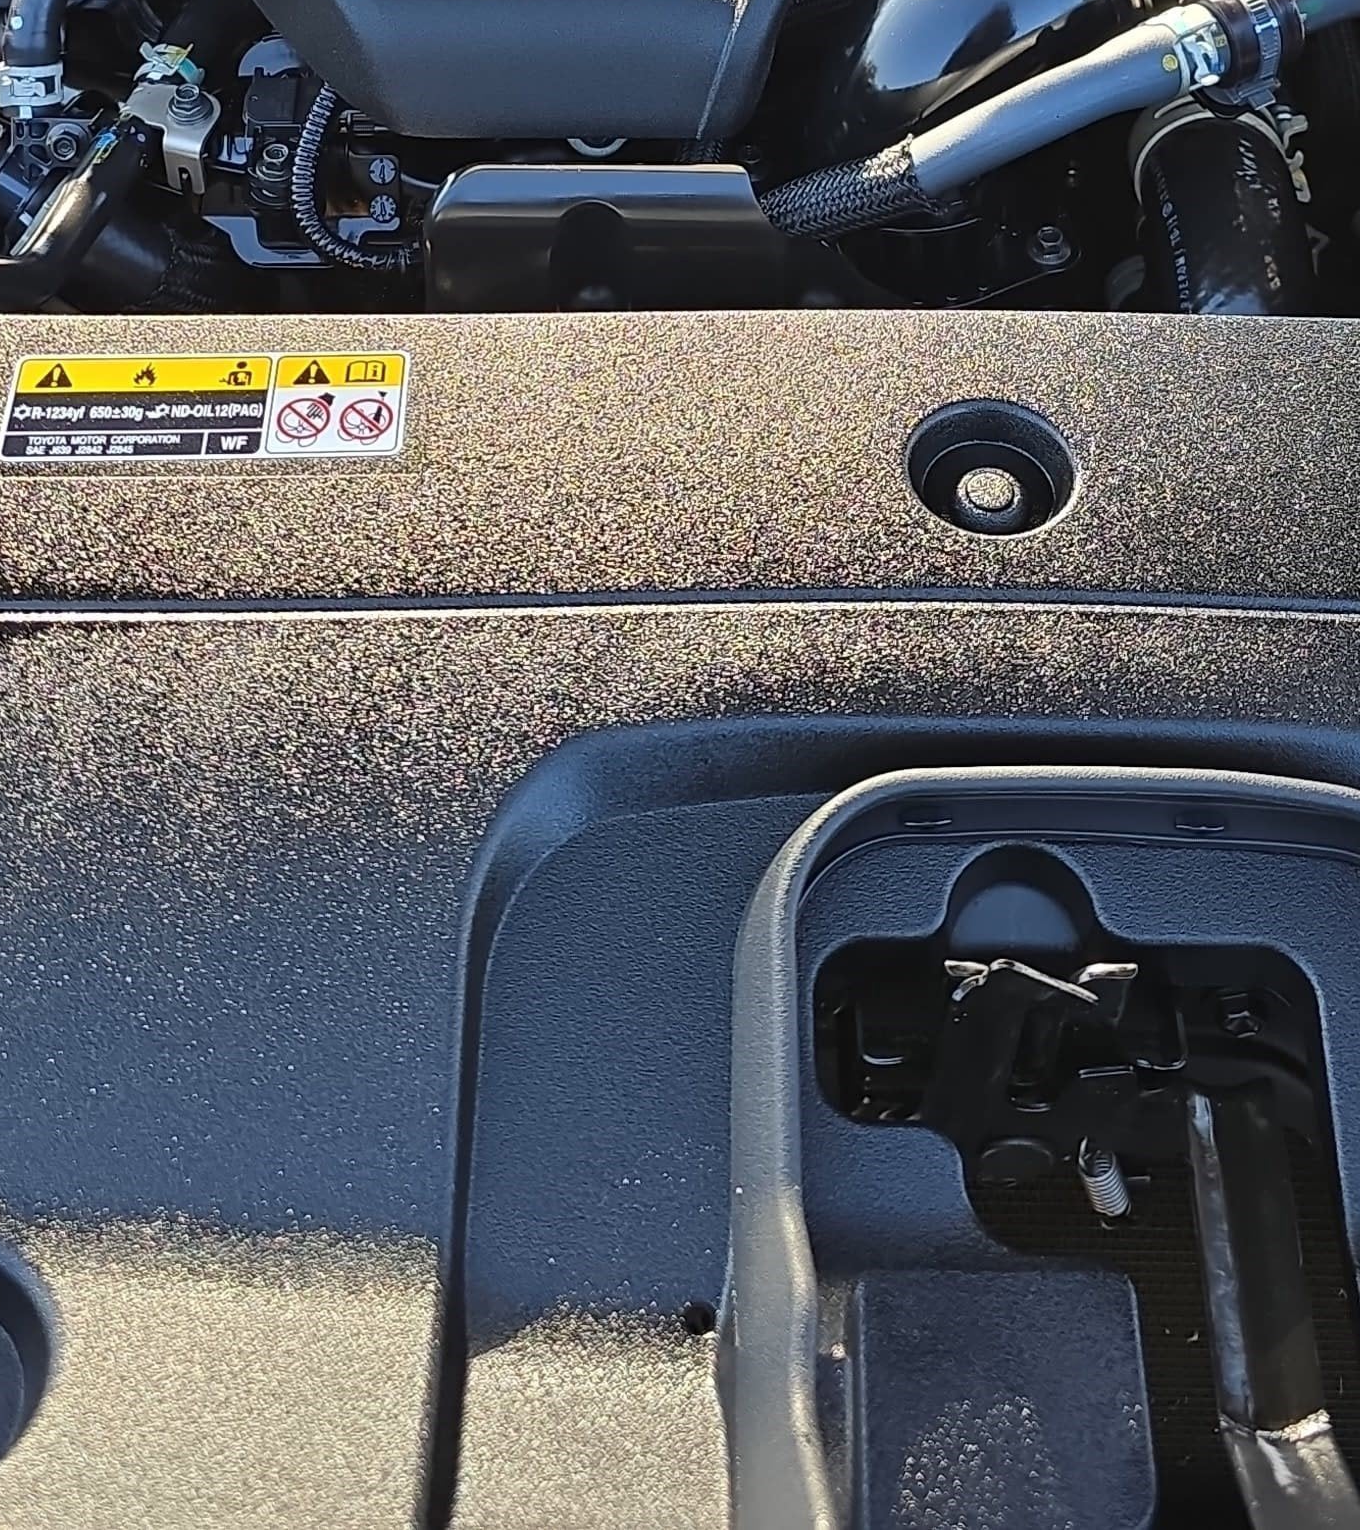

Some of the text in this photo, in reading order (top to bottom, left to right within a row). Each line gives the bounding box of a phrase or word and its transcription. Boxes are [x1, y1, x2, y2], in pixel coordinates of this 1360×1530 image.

[30, 403, 263, 422] R-1234yf 650±30g ND-OIL12(PAG)
[28, 434, 181, 445] TOYOTA MOTOR CORPORATION
[220, 435, 249, 452] WF
[25, 445, 46, 455] SAE
